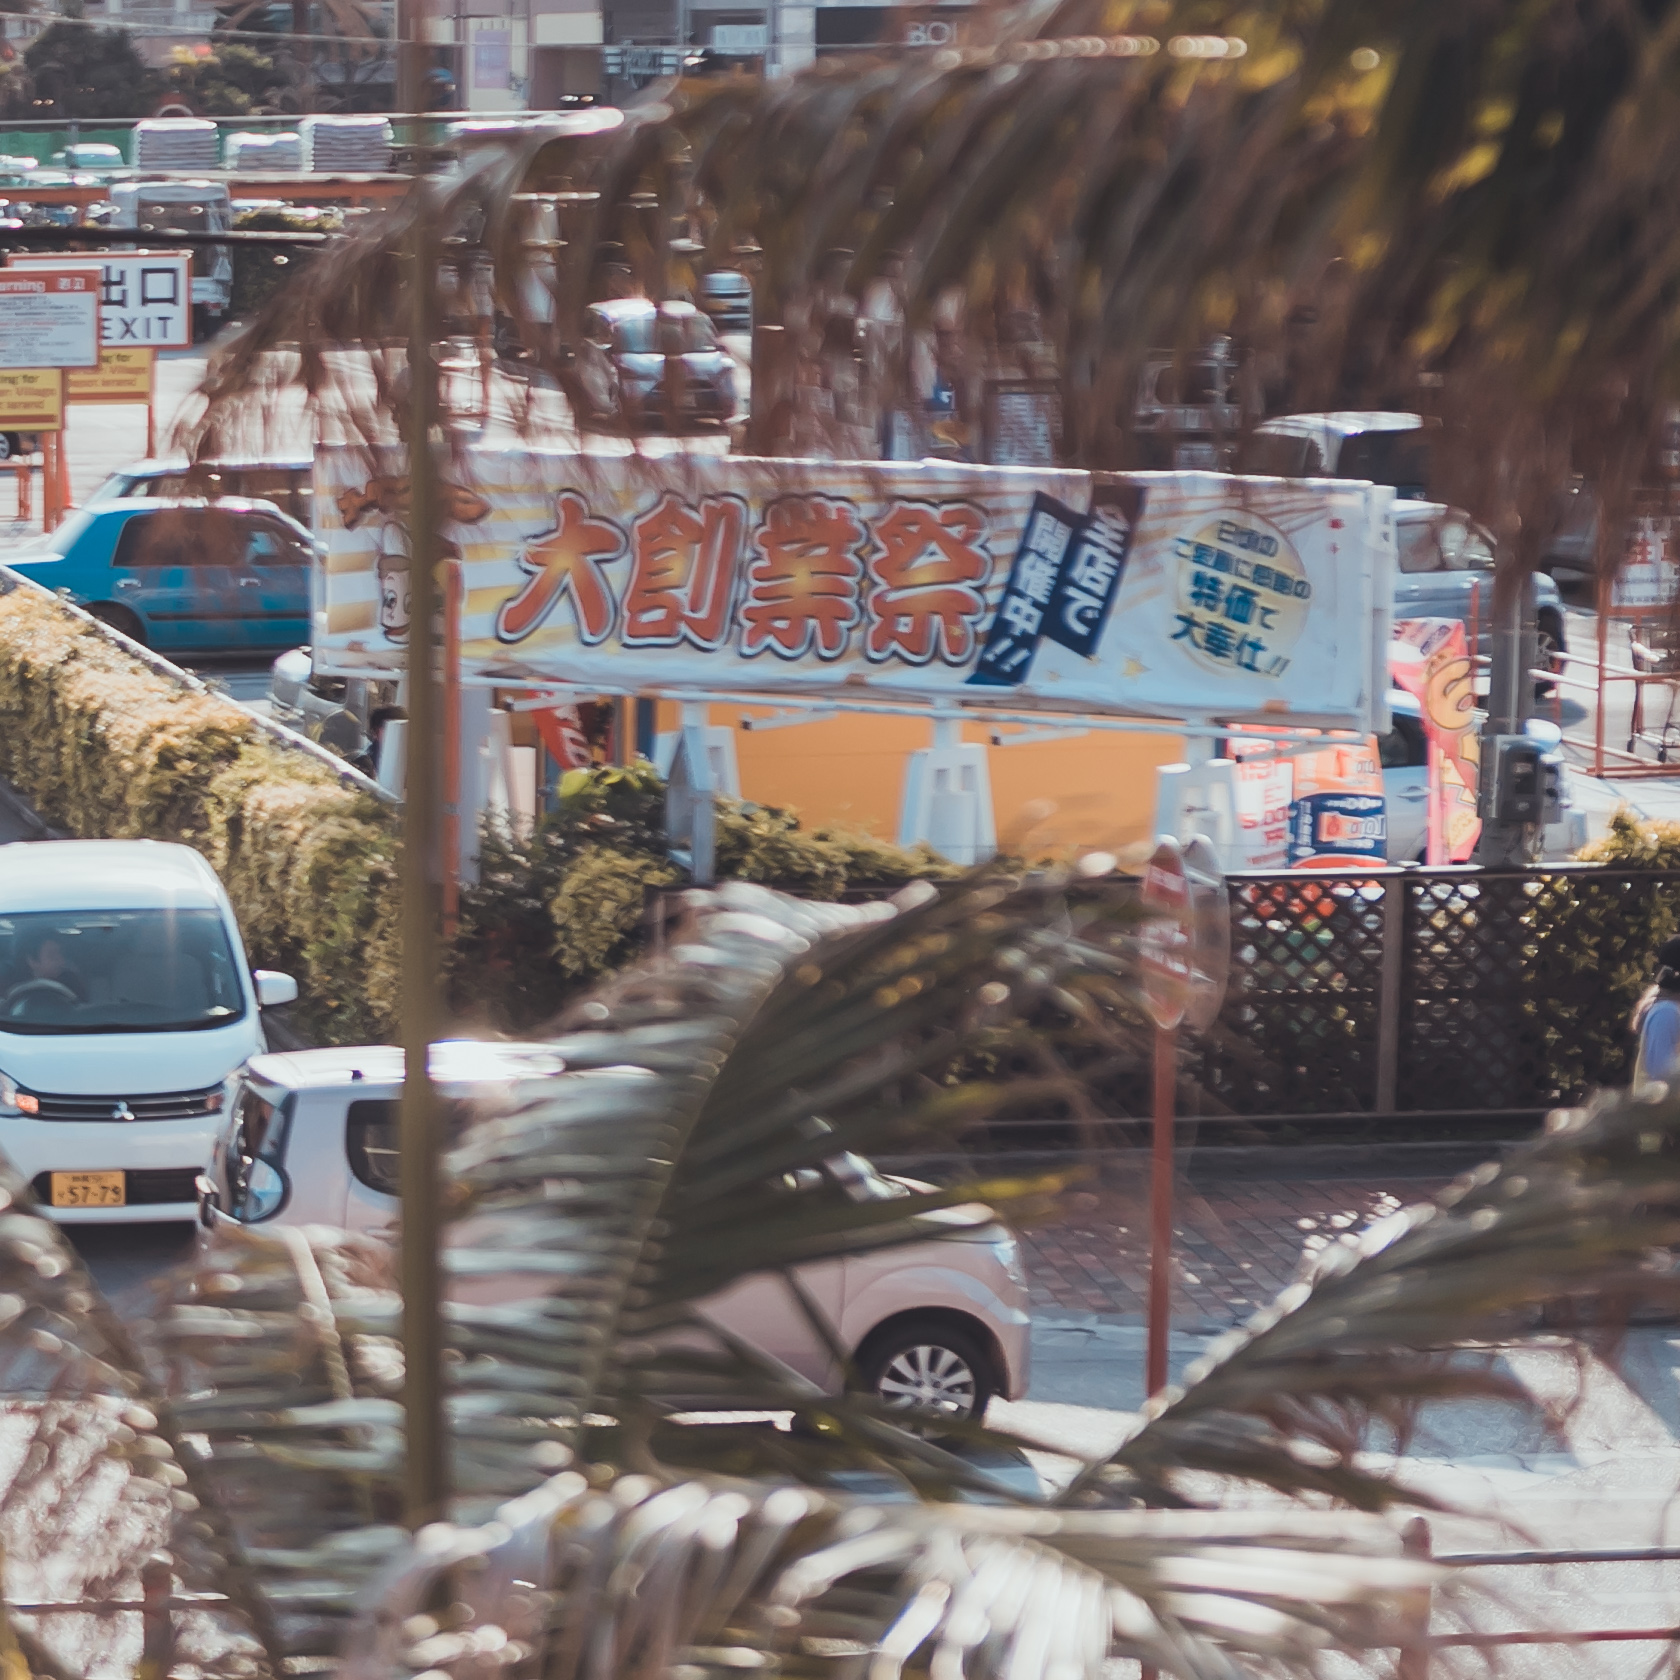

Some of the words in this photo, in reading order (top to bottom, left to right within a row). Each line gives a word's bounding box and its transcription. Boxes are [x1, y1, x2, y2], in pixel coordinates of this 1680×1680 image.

[101, 316, 174, 339] EXIT
[497, 488, 994, 666] 大創業祭
